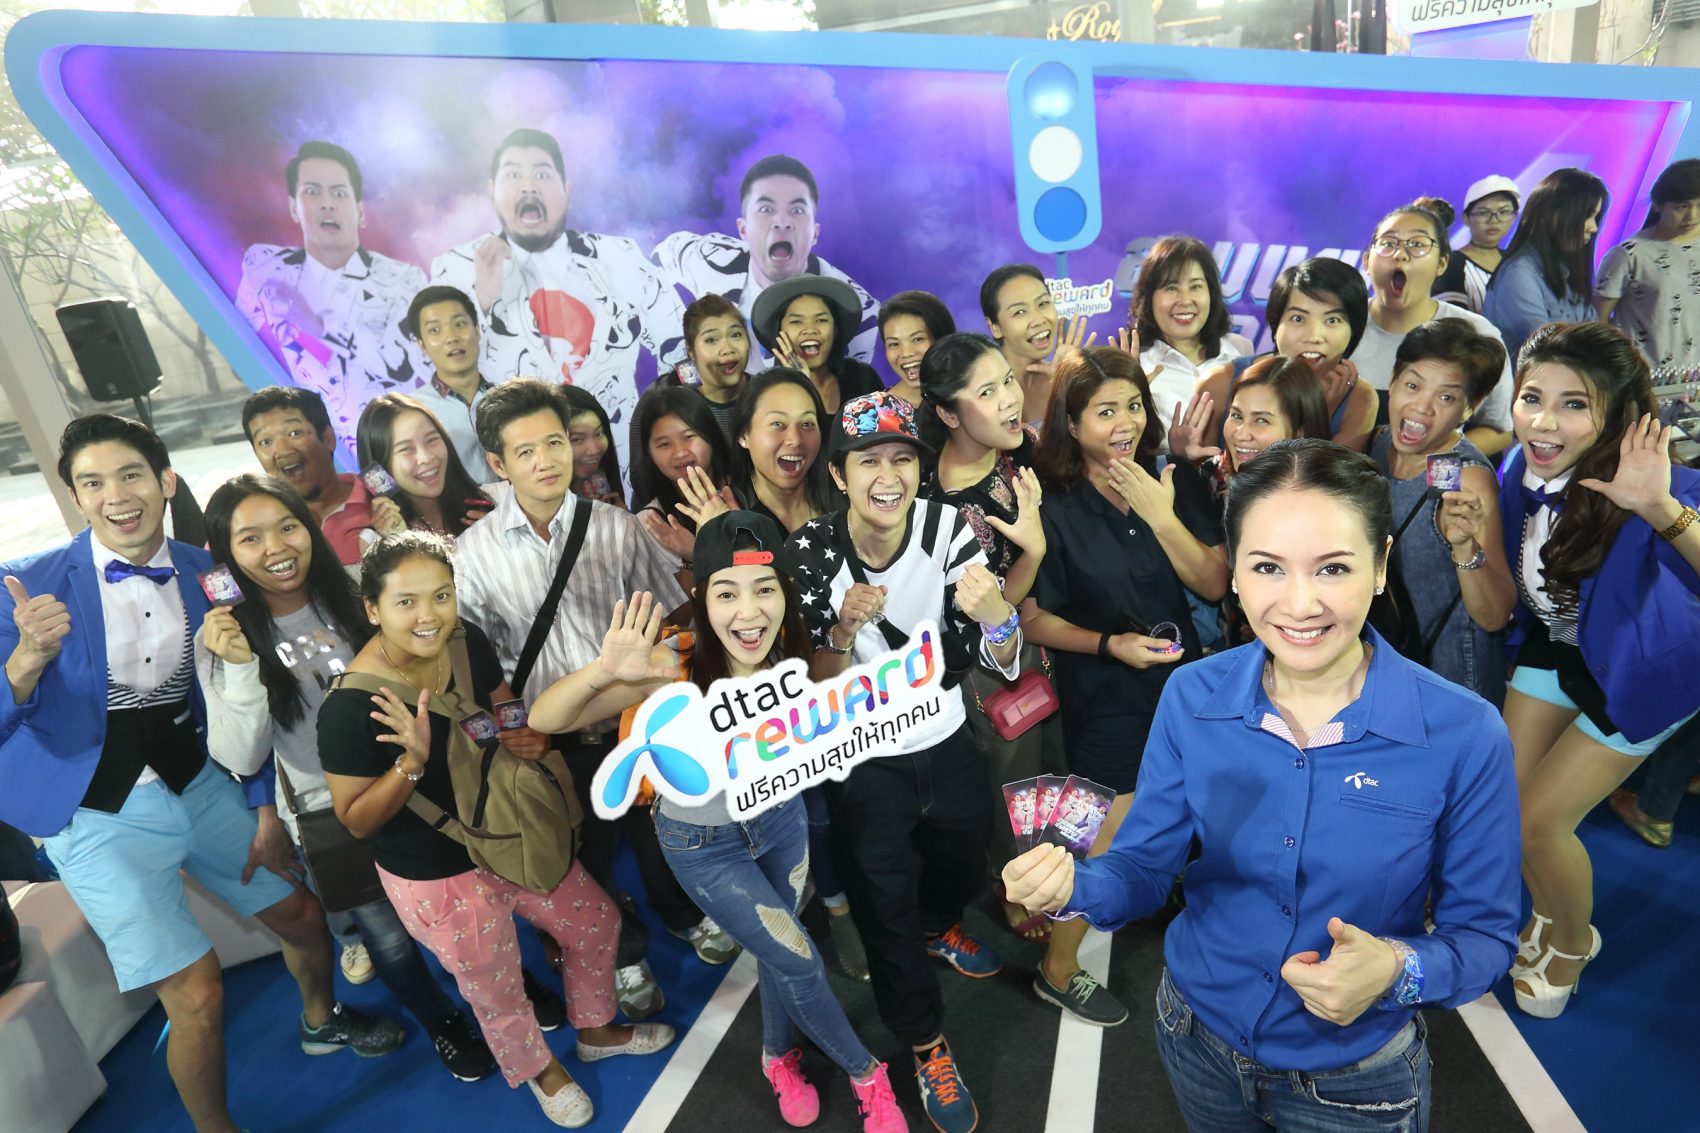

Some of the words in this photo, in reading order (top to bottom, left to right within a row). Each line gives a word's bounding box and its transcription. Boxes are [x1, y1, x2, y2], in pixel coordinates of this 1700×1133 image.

[709, 670, 803, 733] dtac
[736, 696, 941, 812] ฟรีความสุขให้ทุกคน
[1363, 776, 1379, 787] dtac
